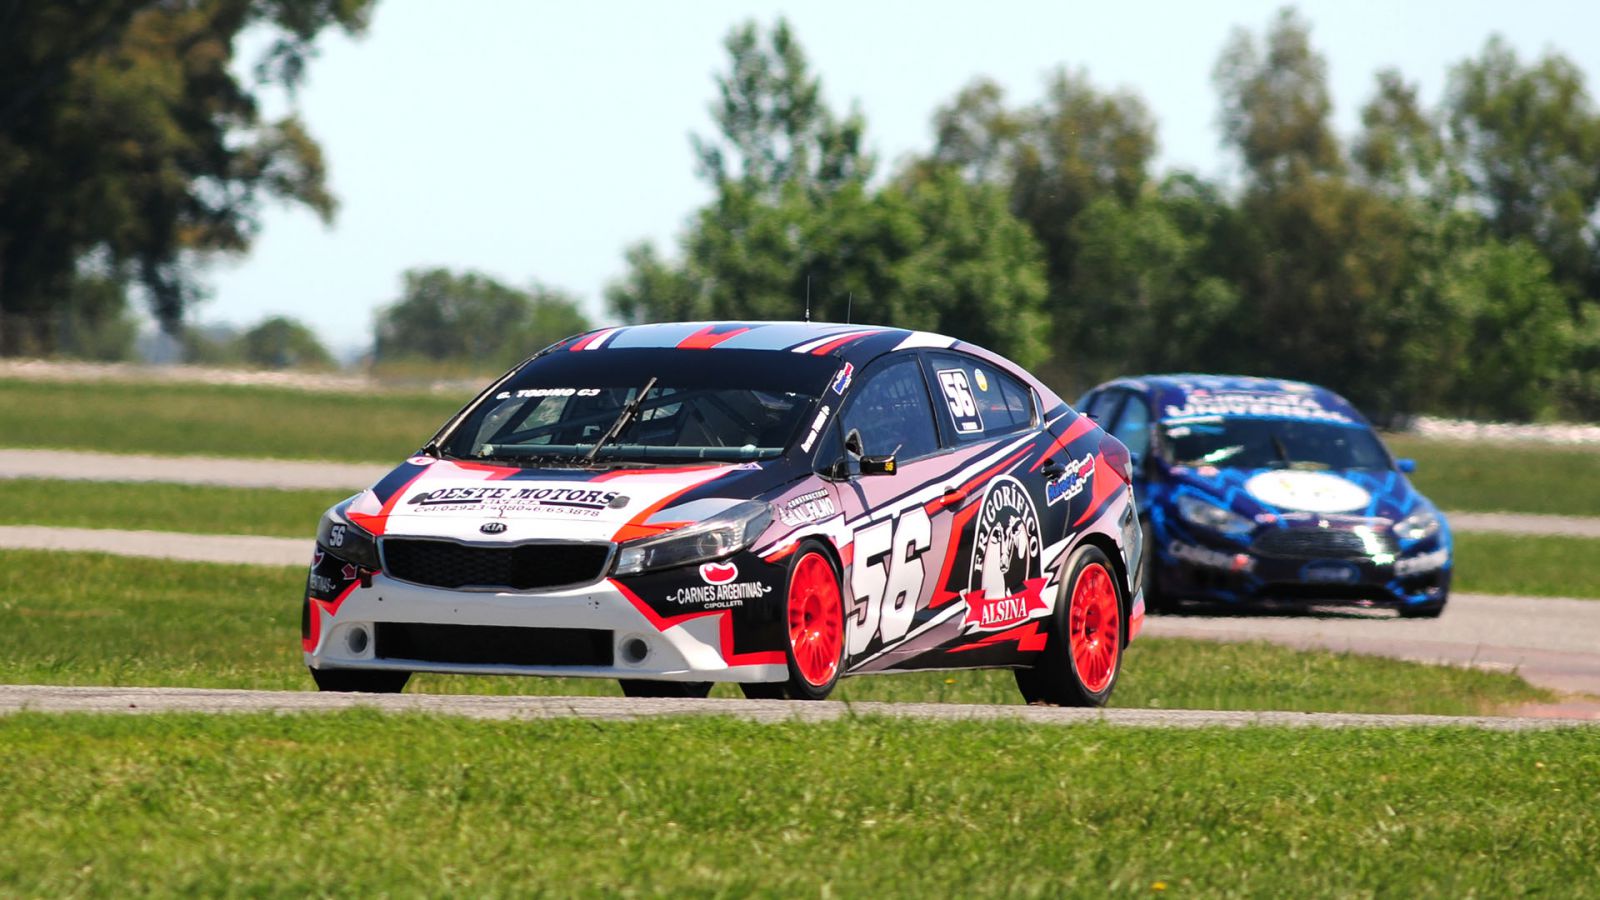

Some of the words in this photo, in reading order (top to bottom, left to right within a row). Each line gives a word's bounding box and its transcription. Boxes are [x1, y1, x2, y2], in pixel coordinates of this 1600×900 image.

[516, 388, 577, 398] TODINO
[939, 372, 976, 418] 56
[884, 461, 894, 472] 56
[427, 487, 507, 500] OESTE
[510, 488, 619, 506] MOTORS
[329, 525, 346, 547] 56
[483, 522, 504, 533] KIA
[974, 484, 1038, 571] FRIGORÍFICO
[846, 504, 932, 656] 56
[677, 585, 715, 604] CARNES
[716, 581, 763, 600] ARGENTINAS
[980, 597, 1028, 625] ALSINA
